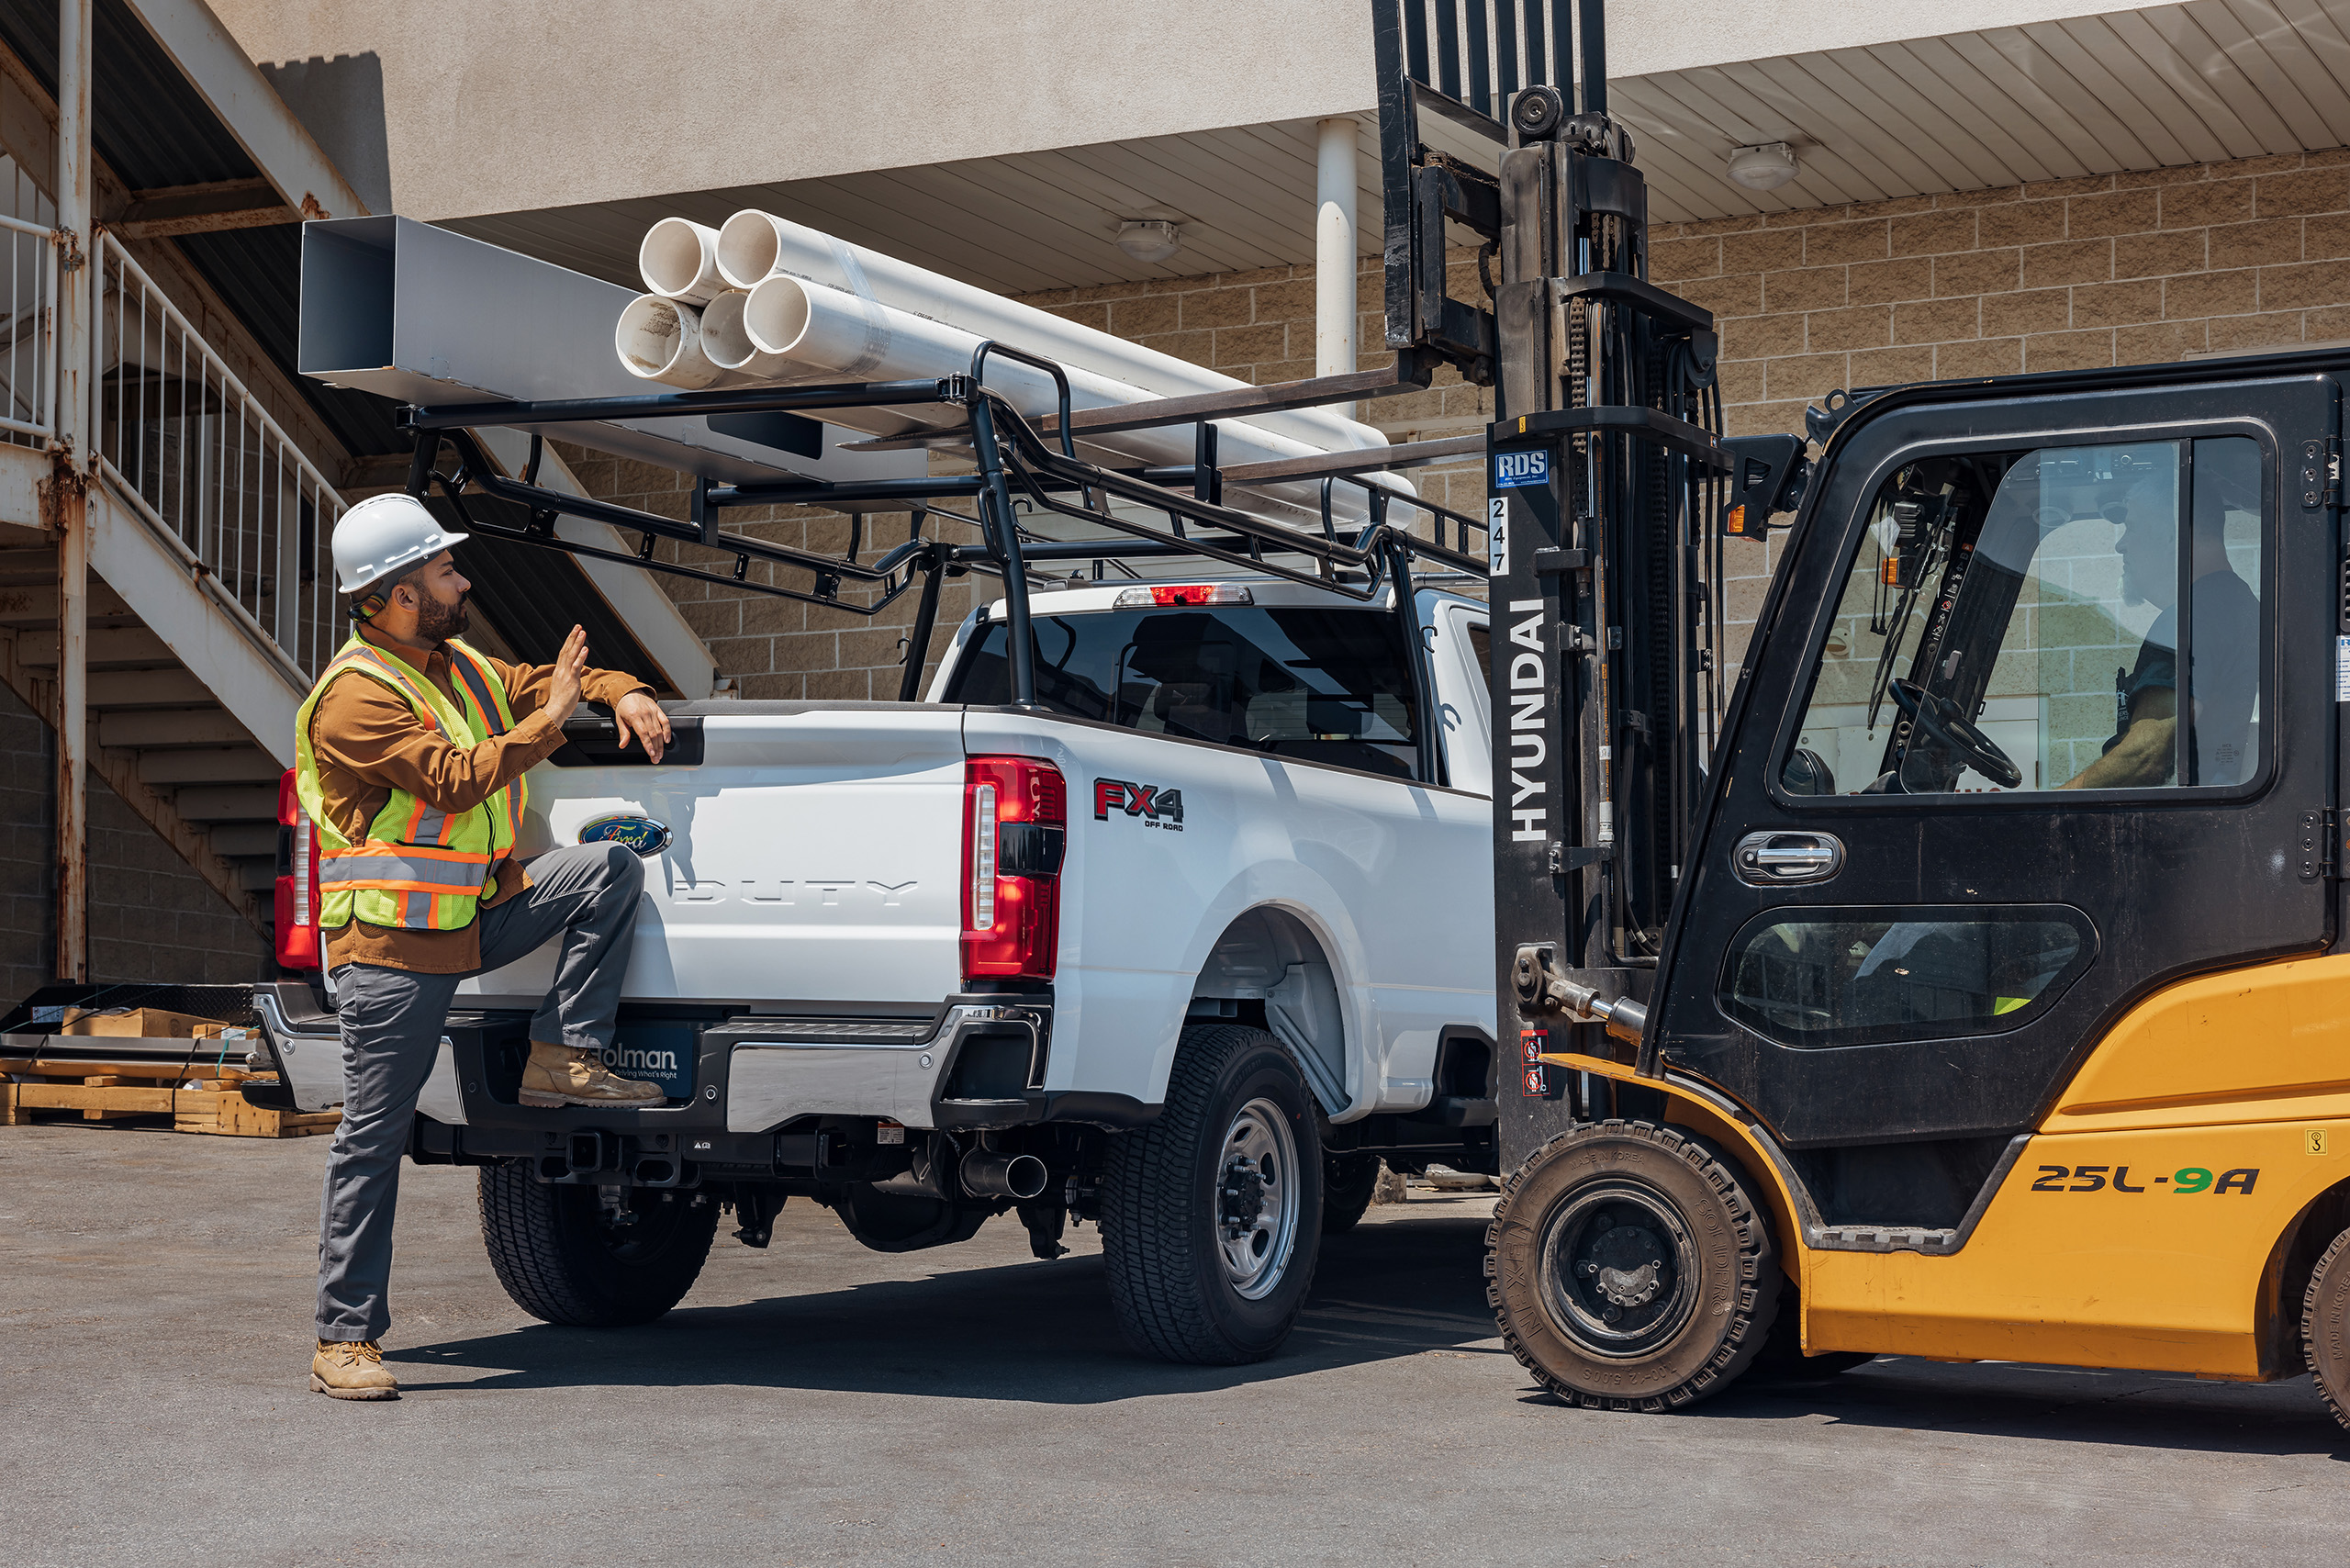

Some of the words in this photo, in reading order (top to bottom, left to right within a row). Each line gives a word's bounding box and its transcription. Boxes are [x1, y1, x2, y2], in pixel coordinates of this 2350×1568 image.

[1498, 453, 1545, 477] RDS
[1508, 599, 1547, 843] HYUNDAI
[1093, 777, 1184, 823] FX4
[1145, 821, 1160, 829] OFF
[1163, 823, 1183, 832] ROAD
[674, 880, 919, 906] DUTY
[660, 1071, 677, 1081] Right
[1570, 1153, 1597, 1170] MADE
[1599, 1151, 1608, 1161] IN
[1610, 1150, 1645, 1165] KOREA
[1505, 1214, 1544, 1339] NEXEN
[2330, 1325, 2344, 1361] MADE
